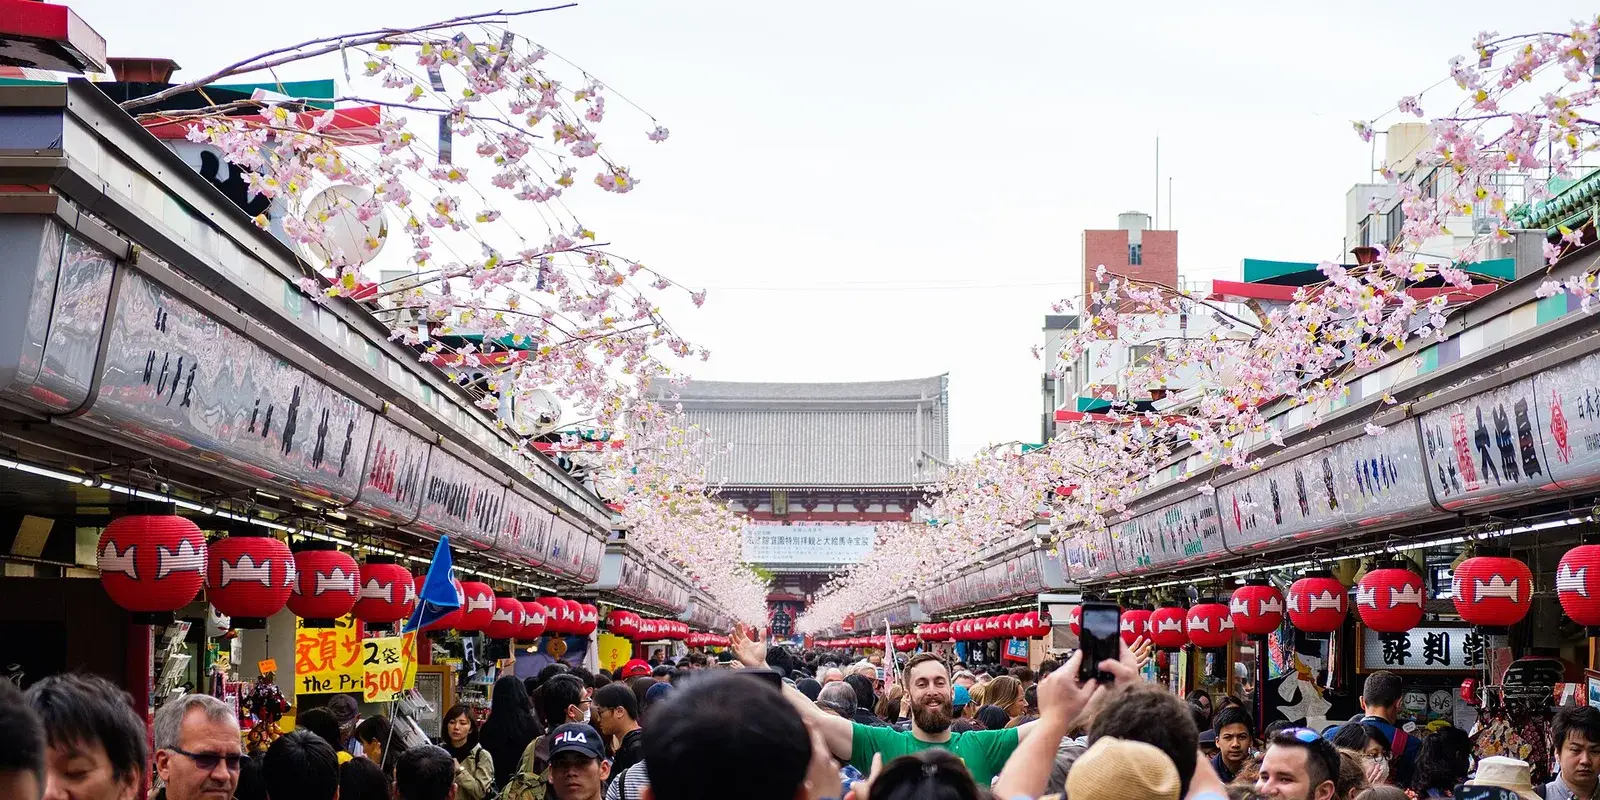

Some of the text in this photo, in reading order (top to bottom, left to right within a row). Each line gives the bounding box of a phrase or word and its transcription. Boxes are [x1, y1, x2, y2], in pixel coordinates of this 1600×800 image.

[364, 642, 399, 666] 2袋
[303, 675, 333, 692] the
[365, 668, 403, 699] 500
[554, 731, 587, 745] FILA
